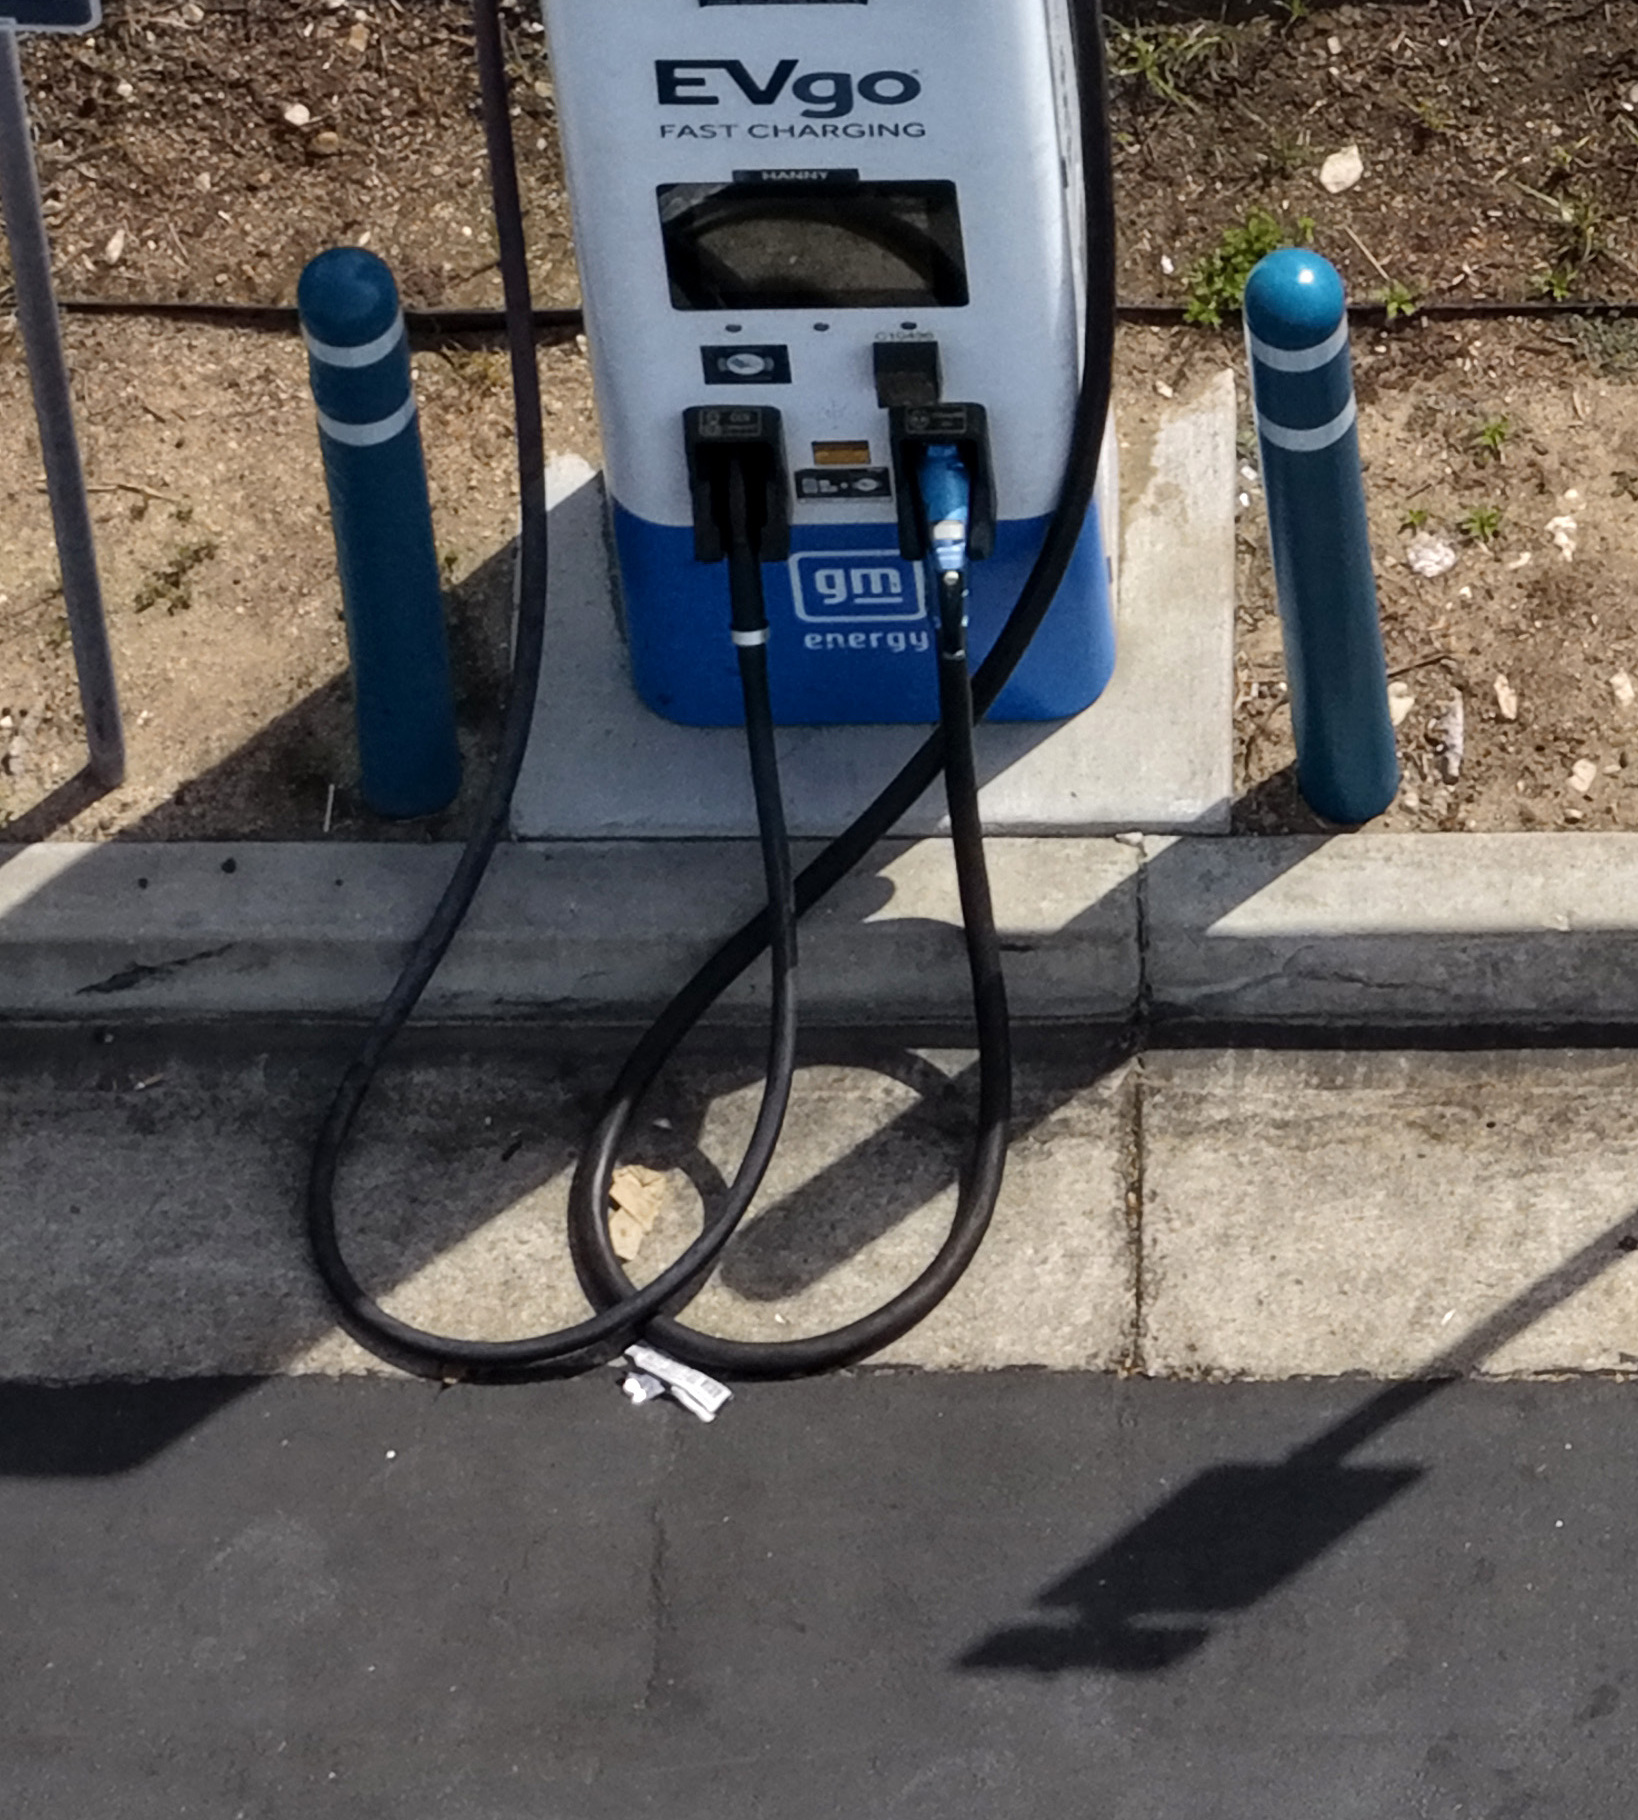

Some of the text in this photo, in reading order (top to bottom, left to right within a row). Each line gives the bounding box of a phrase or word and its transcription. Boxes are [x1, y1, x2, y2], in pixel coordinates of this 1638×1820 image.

[654, 58, 921, 118] EVgo
[659, 122, 926, 139] FAST CHARGING
[815, 566, 904, 605] gm
[803, 629, 931, 653] energy
